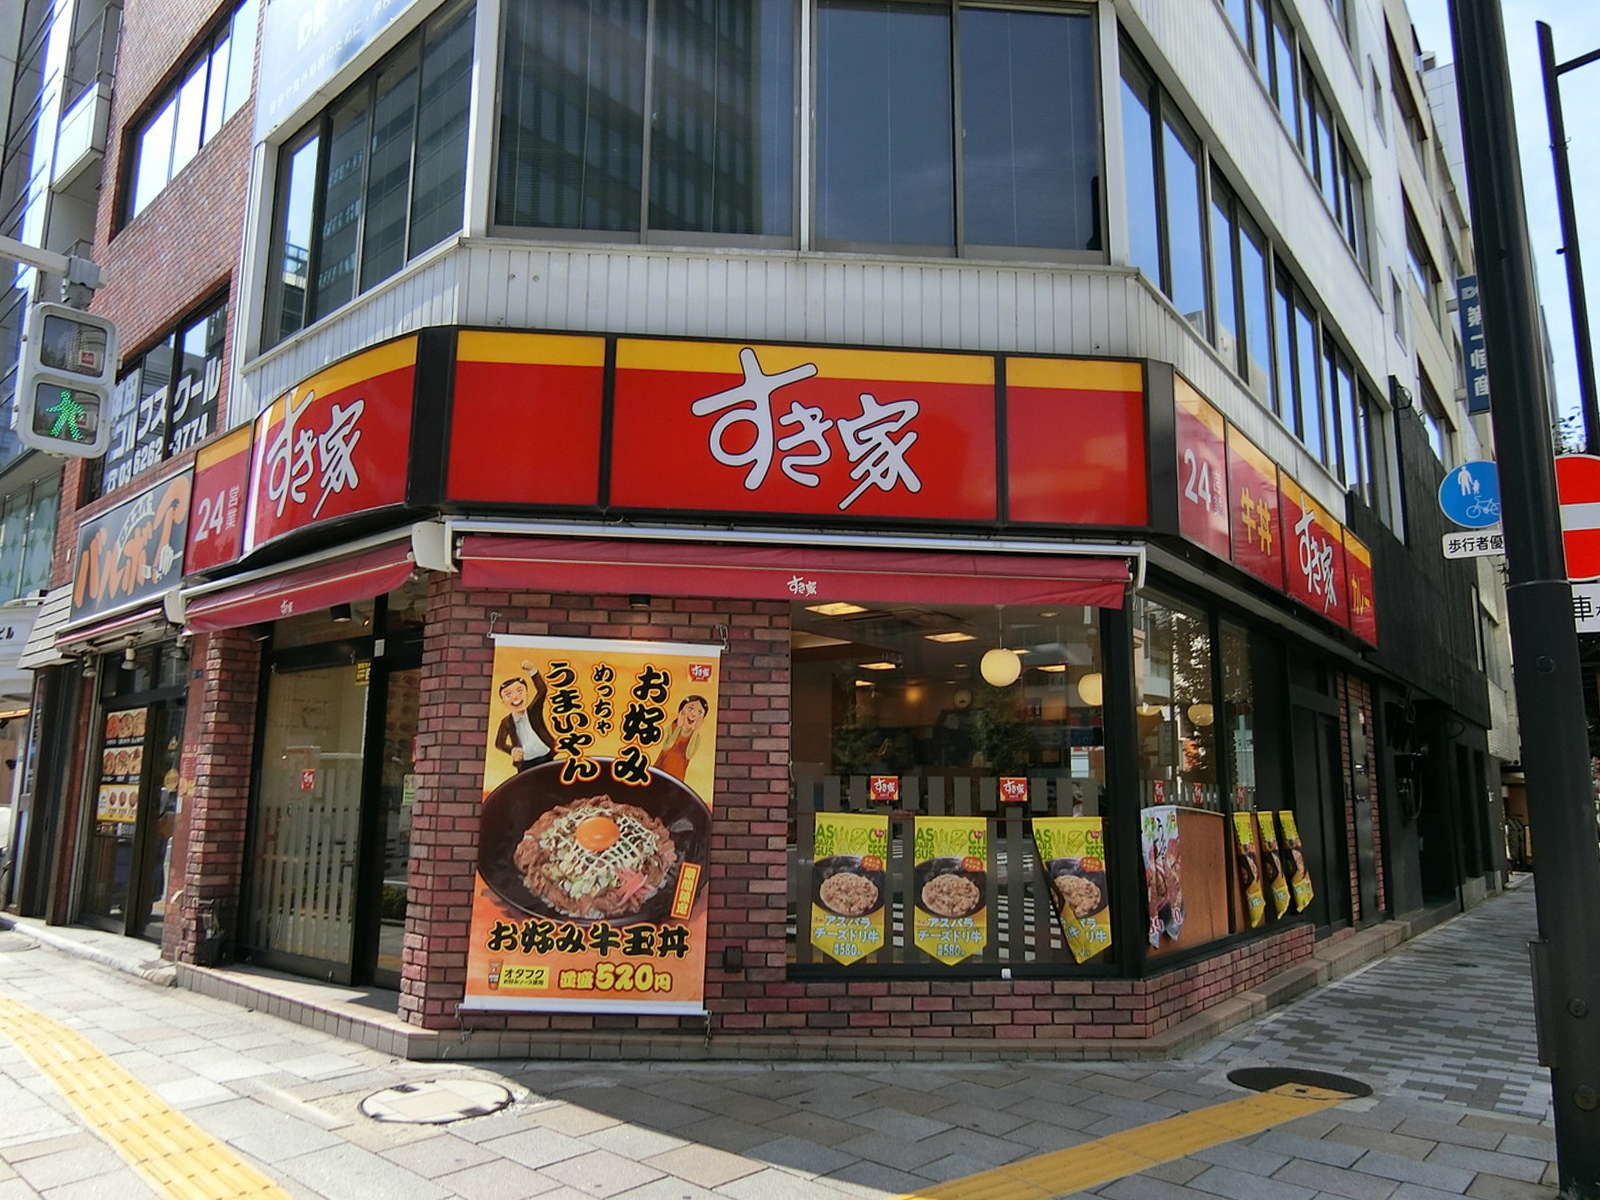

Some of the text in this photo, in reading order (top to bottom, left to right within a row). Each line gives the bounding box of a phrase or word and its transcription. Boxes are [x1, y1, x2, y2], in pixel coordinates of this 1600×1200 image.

[691, 347, 922, 511] すき家
[266, 388, 366, 520] すき家
[117, 459, 131, 487] 03
[1184, 448, 1211, 512] 24
[194, 490, 225, 541] 24
[1241, 486, 1272, 556] 牛丼
[1295, 491, 1337, 613] すき家
[787, 575, 817, 597] すき家
[1572, 595, 1600, 623] 車
[592, 662, 616, 735] めっちゃ
[546, 660, 601, 784] うまいやん
[614, 664, 671, 786] お好み
[873, 778, 896, 793] すき家
[1003, 781, 1025, 795] すき家
[816, 823, 834, 839] AS
[916, 827, 934, 842] AS
[1035, 829, 1051, 844] AS
[814, 846, 834, 856] GUS
[915, 850, 935, 860] GUS
[825, 915, 871, 929] アスパラ
[928, 917, 974, 929] アスパラ
[488, 920, 689, 957] お好み牛玉丼
[815, 928, 880, 943] チーズドリ牛
[918, 929, 982, 943] チーズドリ牛
[504, 968, 545, 979] オタフク
